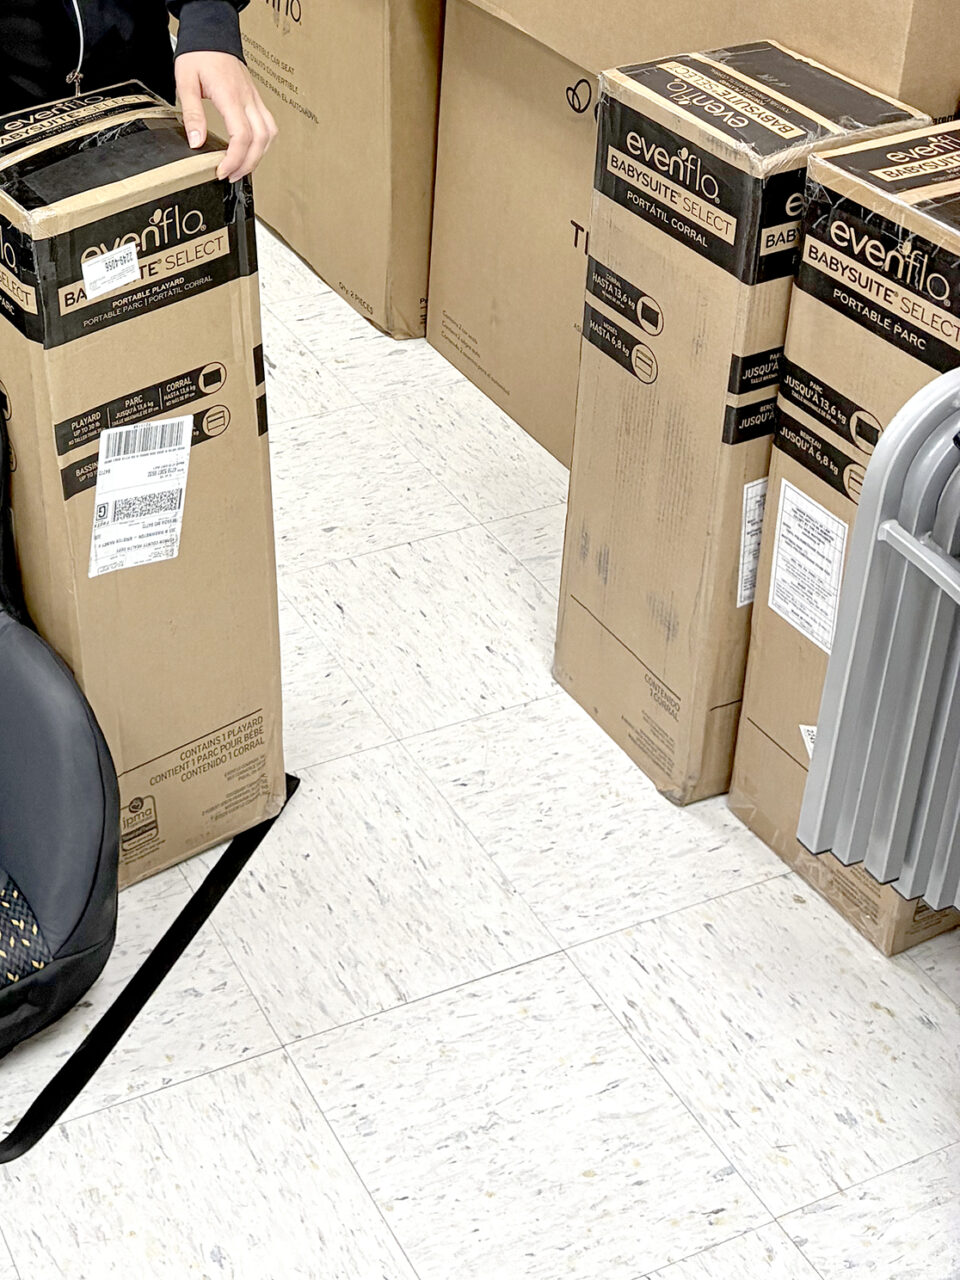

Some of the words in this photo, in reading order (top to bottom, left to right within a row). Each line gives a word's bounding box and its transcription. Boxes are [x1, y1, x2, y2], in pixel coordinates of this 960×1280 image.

[4, 96, 104, 131] evenflo
[666, 78, 749, 129] evenflo
[716, 88, 795, 135] BABYSUITE
[626, 131, 718, 199] evenflo
[886, 135, 960, 162] evenfl
[610, 154, 678, 205] BABYSUITE
[682, 197, 732, 236] SELECT
[627, 190, 670, 224] PORTÁTIL
[671, 219, 708, 248] CORRAL
[166, 236, 224, 271] SELECT
[830, 220, 950, 301] evenflo
[83, 309, 122, 327] PORTABLE
[123, 301, 143, 313] PARC
[184, 275, 213, 291] CORRAL
[112, 290, 151, 308] PORTABLE
[152, 277, 185, 295] PLAYARD
[592, 272, 614, 294] HASTA
[615, 288, 628, 303] 13,6
[628, 297, 636, 310] kg
[808, 244, 895, 305] BABYSUITE
[900, 296, 960, 343] SELECT
[590, 320, 611, 341] HASTA
[612, 336, 622, 349] 6,8
[622, 344, 630, 357] kg
[833, 289, 891, 331] PORTABLE
[893, 326, 927, 351] PARC
[125, 394, 143, 408] PARC
[166, 376, 192, 393] CORRAL
[784, 375, 819, 404] JUSQU'À
[820, 397, 837, 416] 13,6
[838, 410, 847, 425] kg
[810, 381, 824, 395] PARC
[72, 412, 101, 430] PLAYARD
[780, 427, 815, 456] JUSQU'À
[816, 451, 829, 466] 6,8
[830, 461, 839, 476] kg
[645, 674, 680, 712] CONTENIDO
[180, 736, 220, 761] CONTAINS
[222, 732, 226, 742] 1
[227, 716, 264, 739] PLAYARD
[180, 756, 226, 783] CONTENIDO
[228, 750, 233, 759] 1
[233, 738, 265, 758] CORRAL
[149, 761, 190, 786] CONTIENT
[191, 758, 196, 768] 1
[197, 747, 220, 764] PARC
[220, 737, 243, 753] POUR
